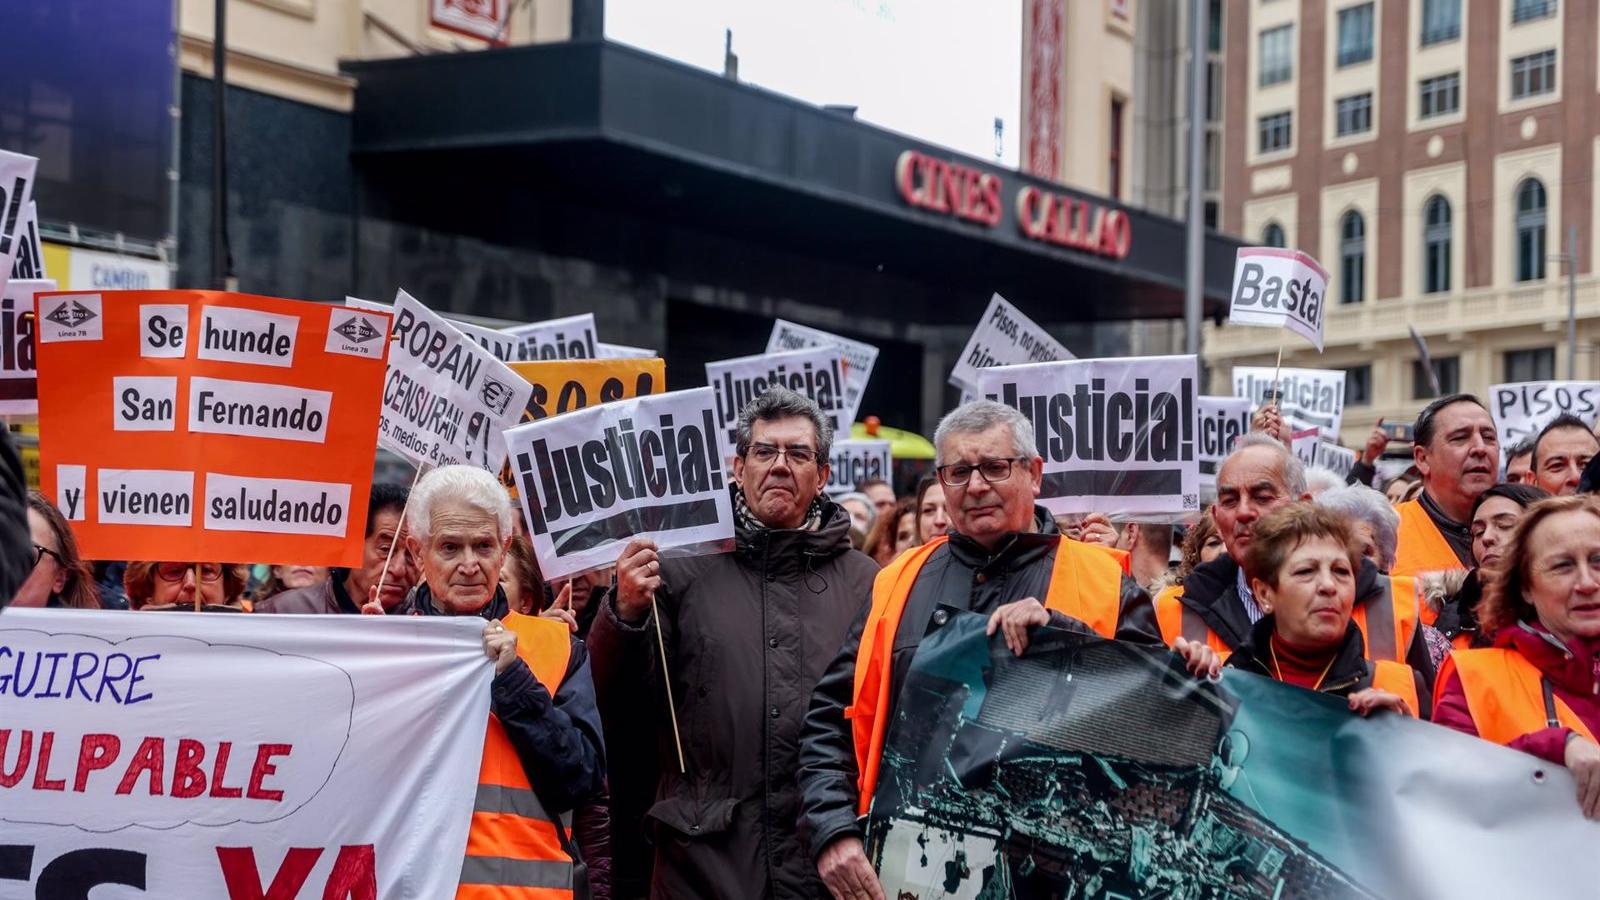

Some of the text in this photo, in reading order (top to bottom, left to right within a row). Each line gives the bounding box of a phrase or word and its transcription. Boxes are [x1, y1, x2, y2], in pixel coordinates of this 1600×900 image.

[896, 150, 1132, 261] CINES CALLAO
[1234, 263, 1325, 330] Basta!
[148, 315, 291, 356] Se hunde
[393, 308, 482, 391] ROBAN
[989, 304, 1019, 346] Pisos,
[1020, 331, 1034, 351] no
[121, 387, 323, 432] San Fernando
[384, 369, 464, 445] CENSURAN
[392, 424, 428, 455] medios
[430, 443, 440, 461] &
[517, 409, 723, 535] ¡Justicia!
[65, 484, 342, 525] y vienen saludando
